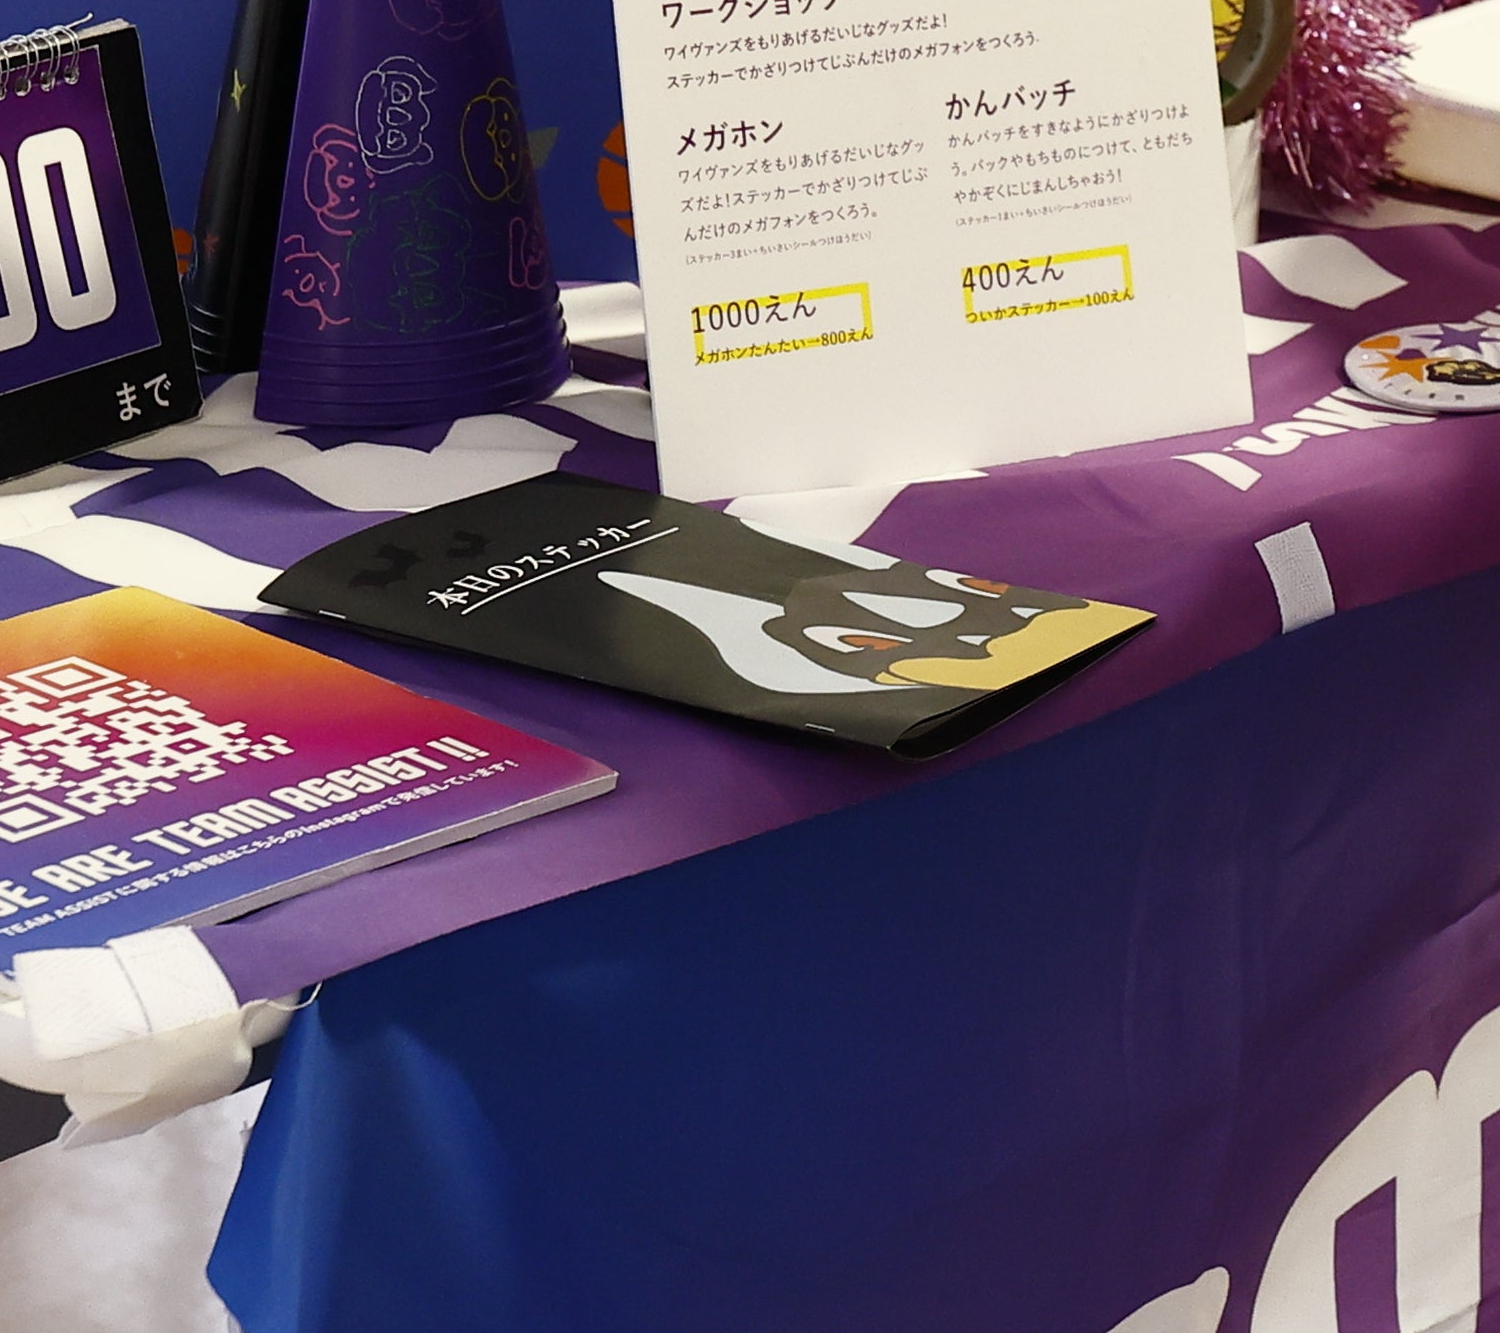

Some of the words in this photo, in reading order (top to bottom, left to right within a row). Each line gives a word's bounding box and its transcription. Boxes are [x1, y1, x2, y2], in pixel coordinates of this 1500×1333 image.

[945, 78, 1077, 121] かんバッチ
[676, 119, 785, 157] メガホン
[678, 138, 926, 185] ワイヴァンズをもりあげるだいじなグッ
[683, 203, 879, 243] んだけのメガフォンをつくろう。
[961, 254, 1066, 294] 400えん
[690, 291, 818, 335] 1000えん
[114, 372, 173, 423] まで
[426, 518, 652, 610] 本日のステッカー
[31, 844, 155, 894] ARE
[130, 797, 296, 856] TEAM
[268, 746, 449, 813] ASSIST
